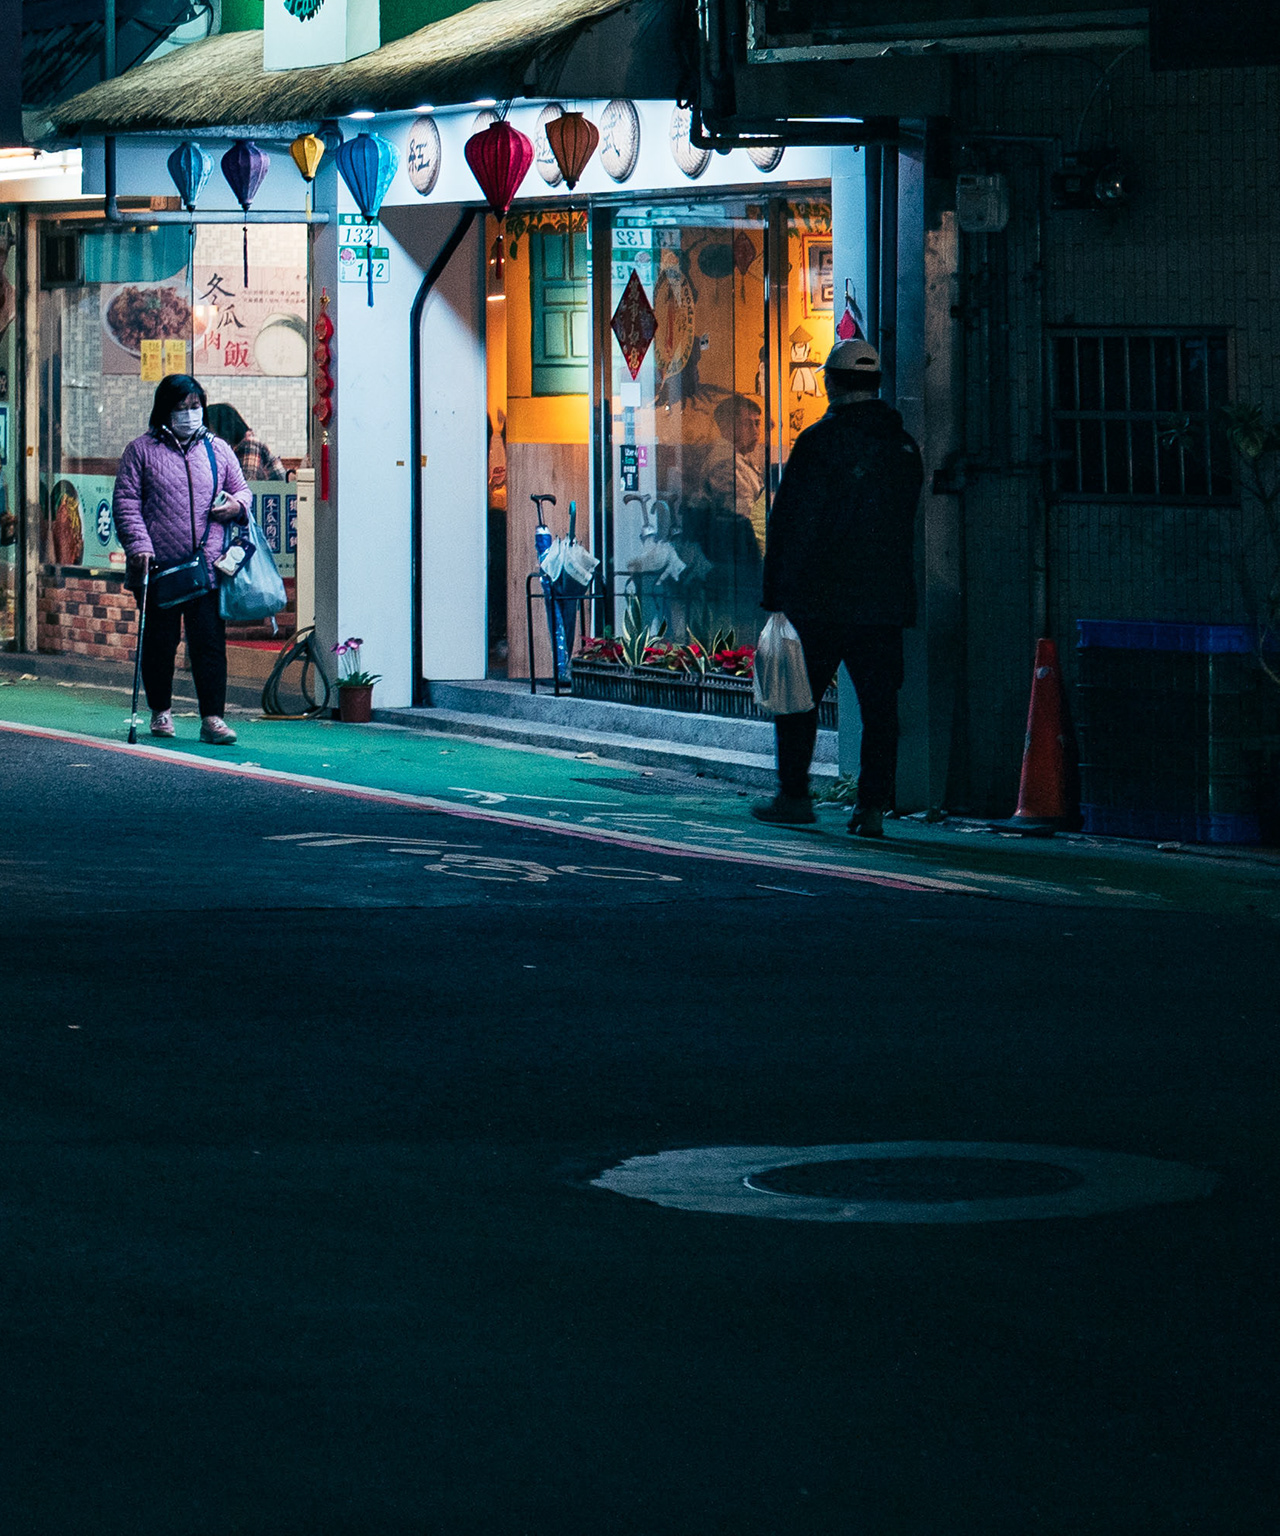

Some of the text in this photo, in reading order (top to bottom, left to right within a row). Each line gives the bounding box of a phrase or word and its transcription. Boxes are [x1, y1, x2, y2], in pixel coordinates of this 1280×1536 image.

[344, 228, 374, 243] 132
[199, 272, 250, 368] 冬瓜肉飯
